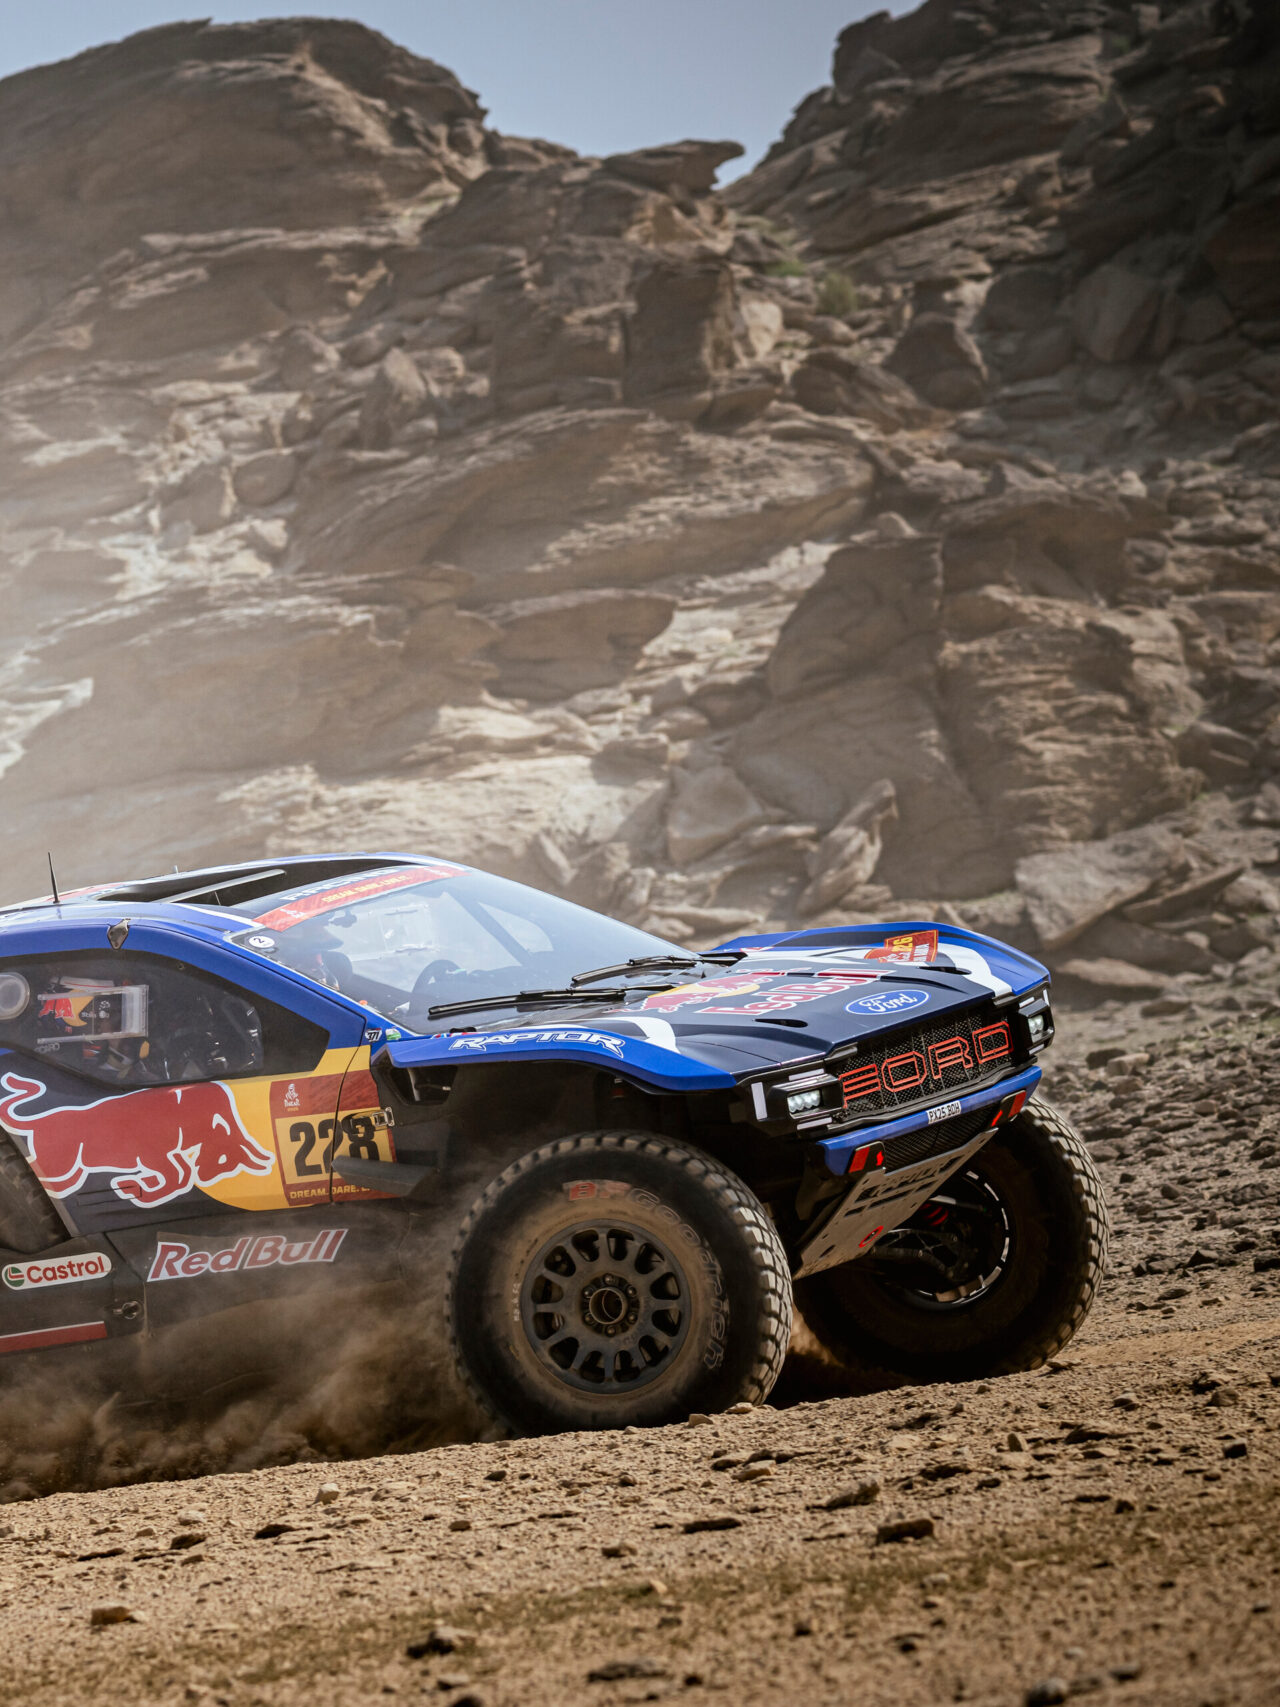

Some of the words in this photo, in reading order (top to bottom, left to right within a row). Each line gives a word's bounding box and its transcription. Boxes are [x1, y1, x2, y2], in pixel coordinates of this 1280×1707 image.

[858, 994, 918, 1013] Ford
[450, 1031, 625, 1058] RAPTOR
[838, 1020, 1014, 1109] FORD
[289, 1116, 380, 1177] 228
[290, 1186, 329, 1199] DREAM.
[148, 1237, 251, 1281] Red
[244, 1229, 348, 1269] Bull
[26, 1256, 105, 1284] Castrol
